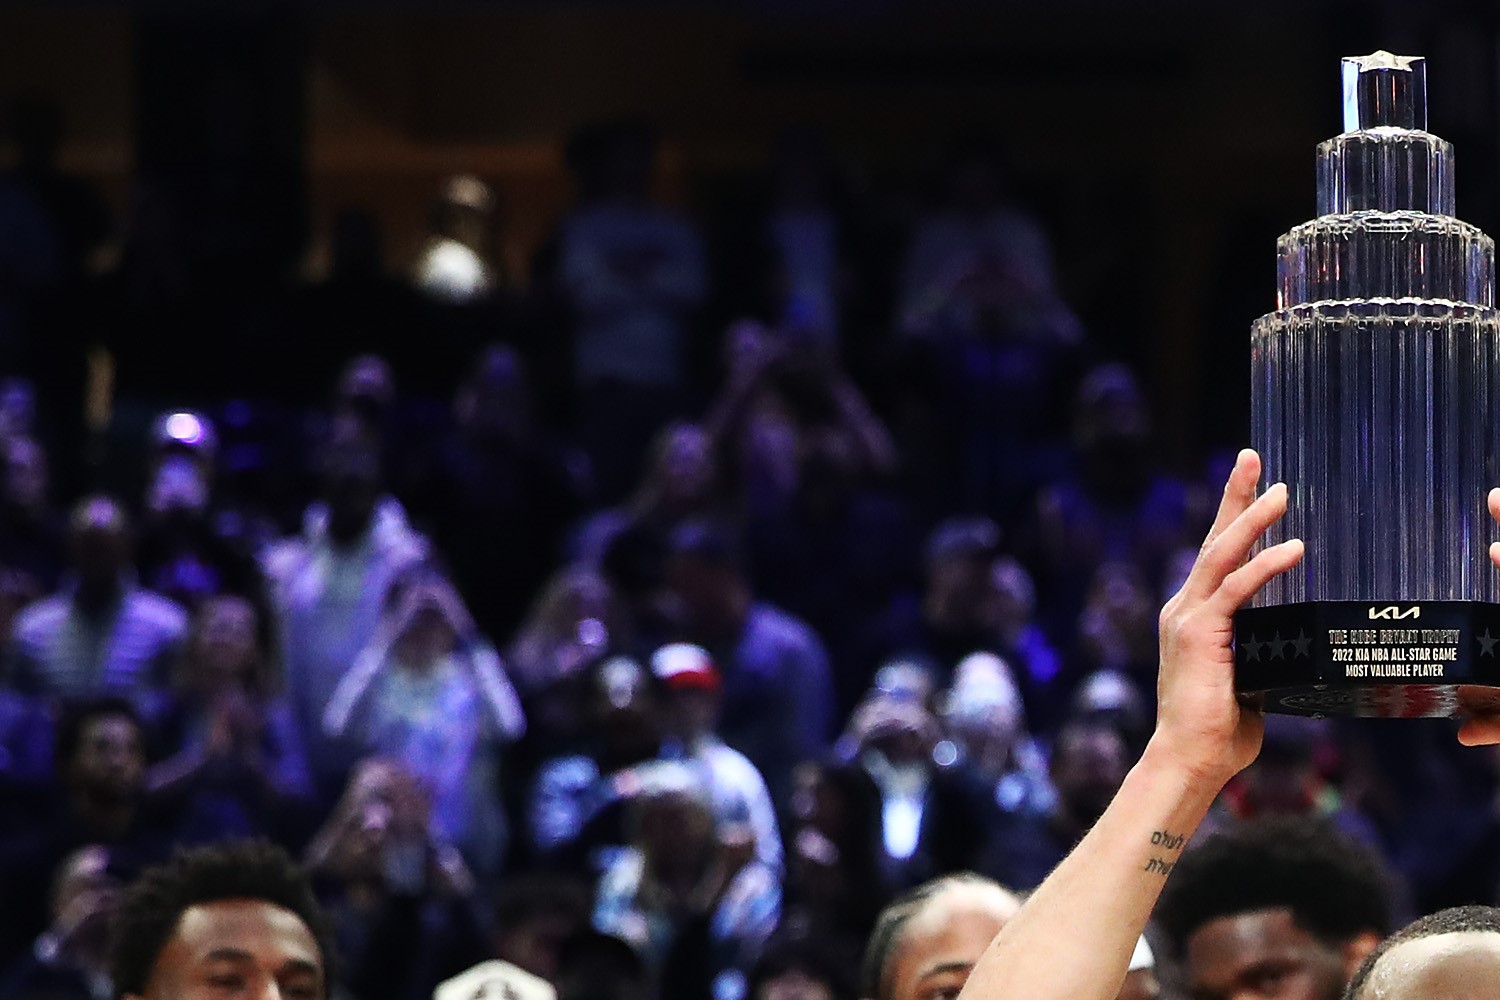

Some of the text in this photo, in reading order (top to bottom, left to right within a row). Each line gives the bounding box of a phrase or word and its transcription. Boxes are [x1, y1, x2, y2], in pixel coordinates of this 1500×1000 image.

[1368, 606, 1420, 620] KIA
[1328, 629, 1461, 645] THE KOBE BRYANT TROPHY
[1332, 647, 1457, 662] 2022 KIA NBA ALL-STAR GAME
[1345, 664, 1444, 677] MOST VALUABLE PLAYER
